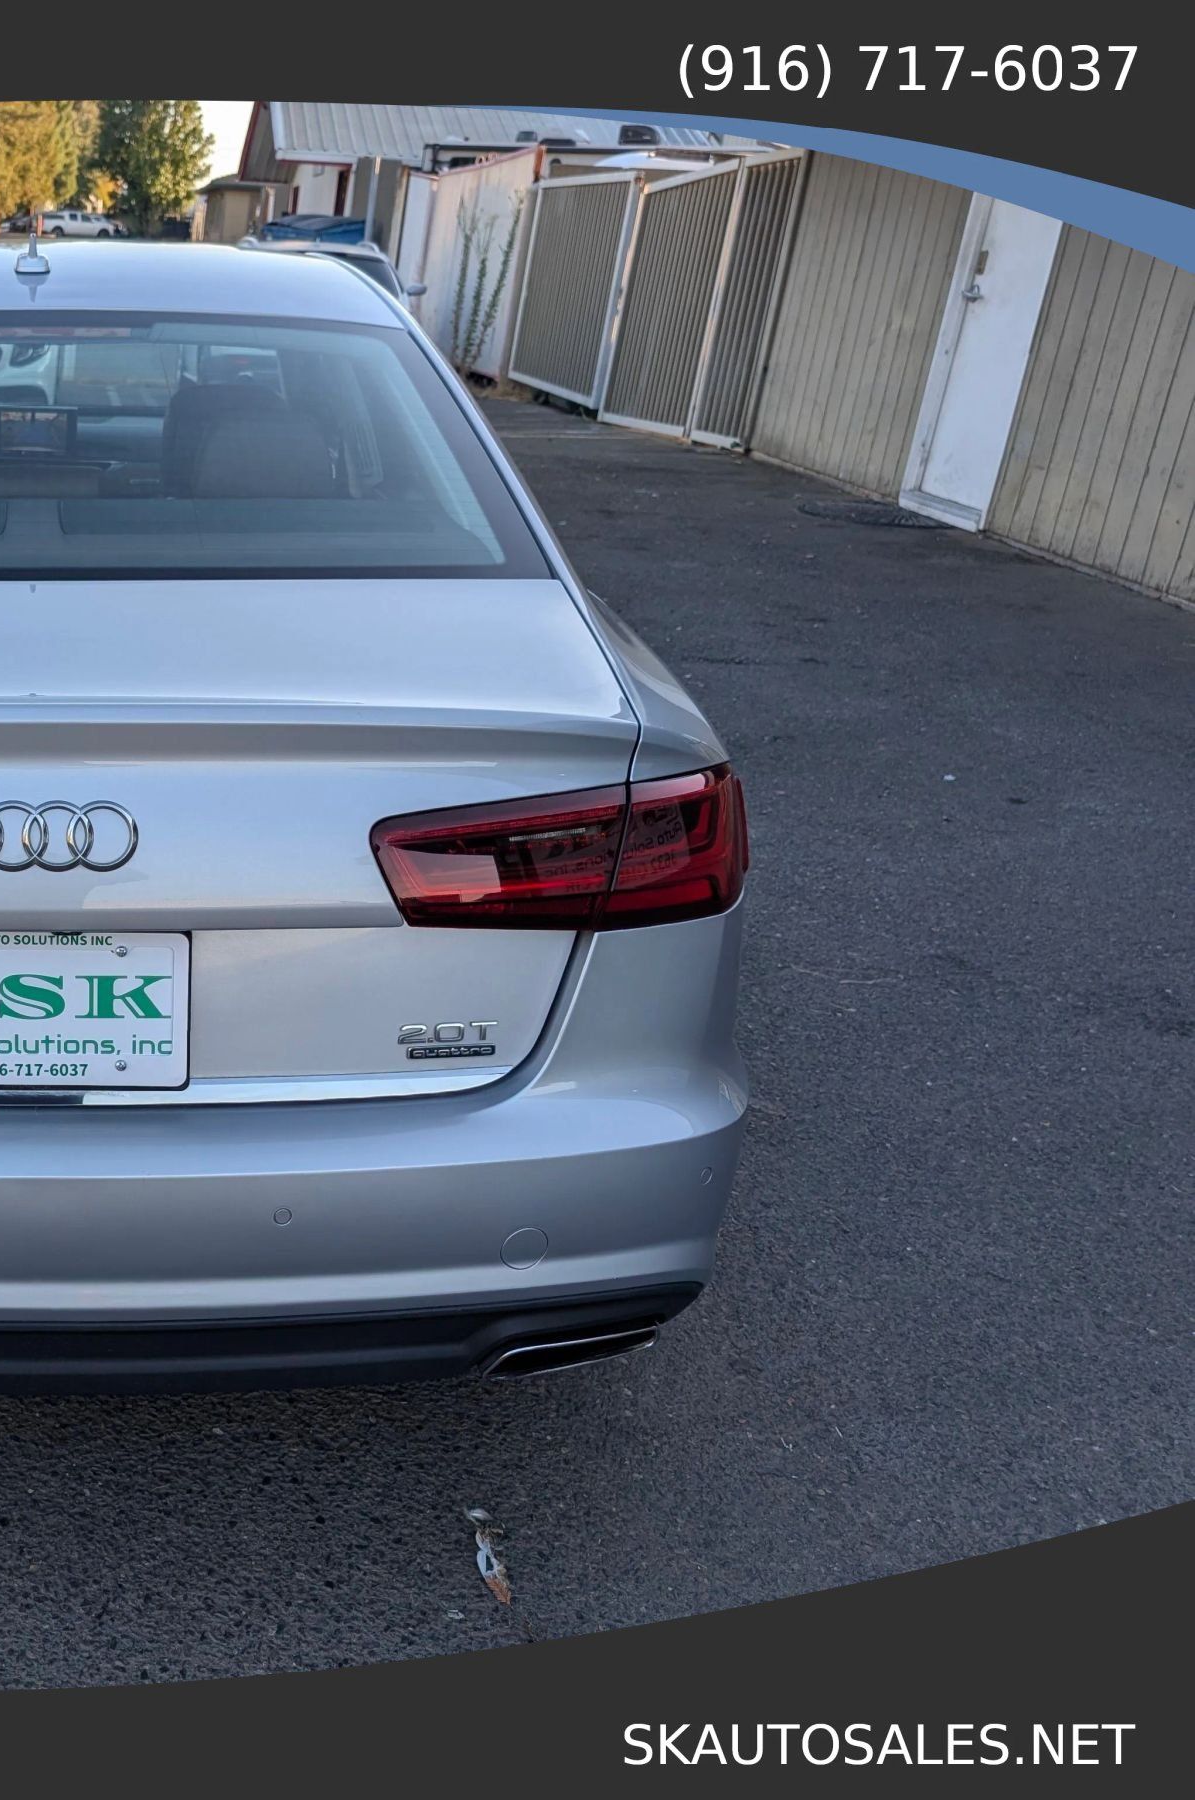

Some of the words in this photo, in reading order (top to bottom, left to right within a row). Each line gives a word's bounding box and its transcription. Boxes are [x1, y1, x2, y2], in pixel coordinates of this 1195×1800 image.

[13, 935, 87, 946] SOLUTIONS
[90, 935, 113, 946] INC
[397, 1020, 499, 1045] 2.0T
[131, 1034, 173, 1056] inc
[411, 1045, 494, 1058] quattro
